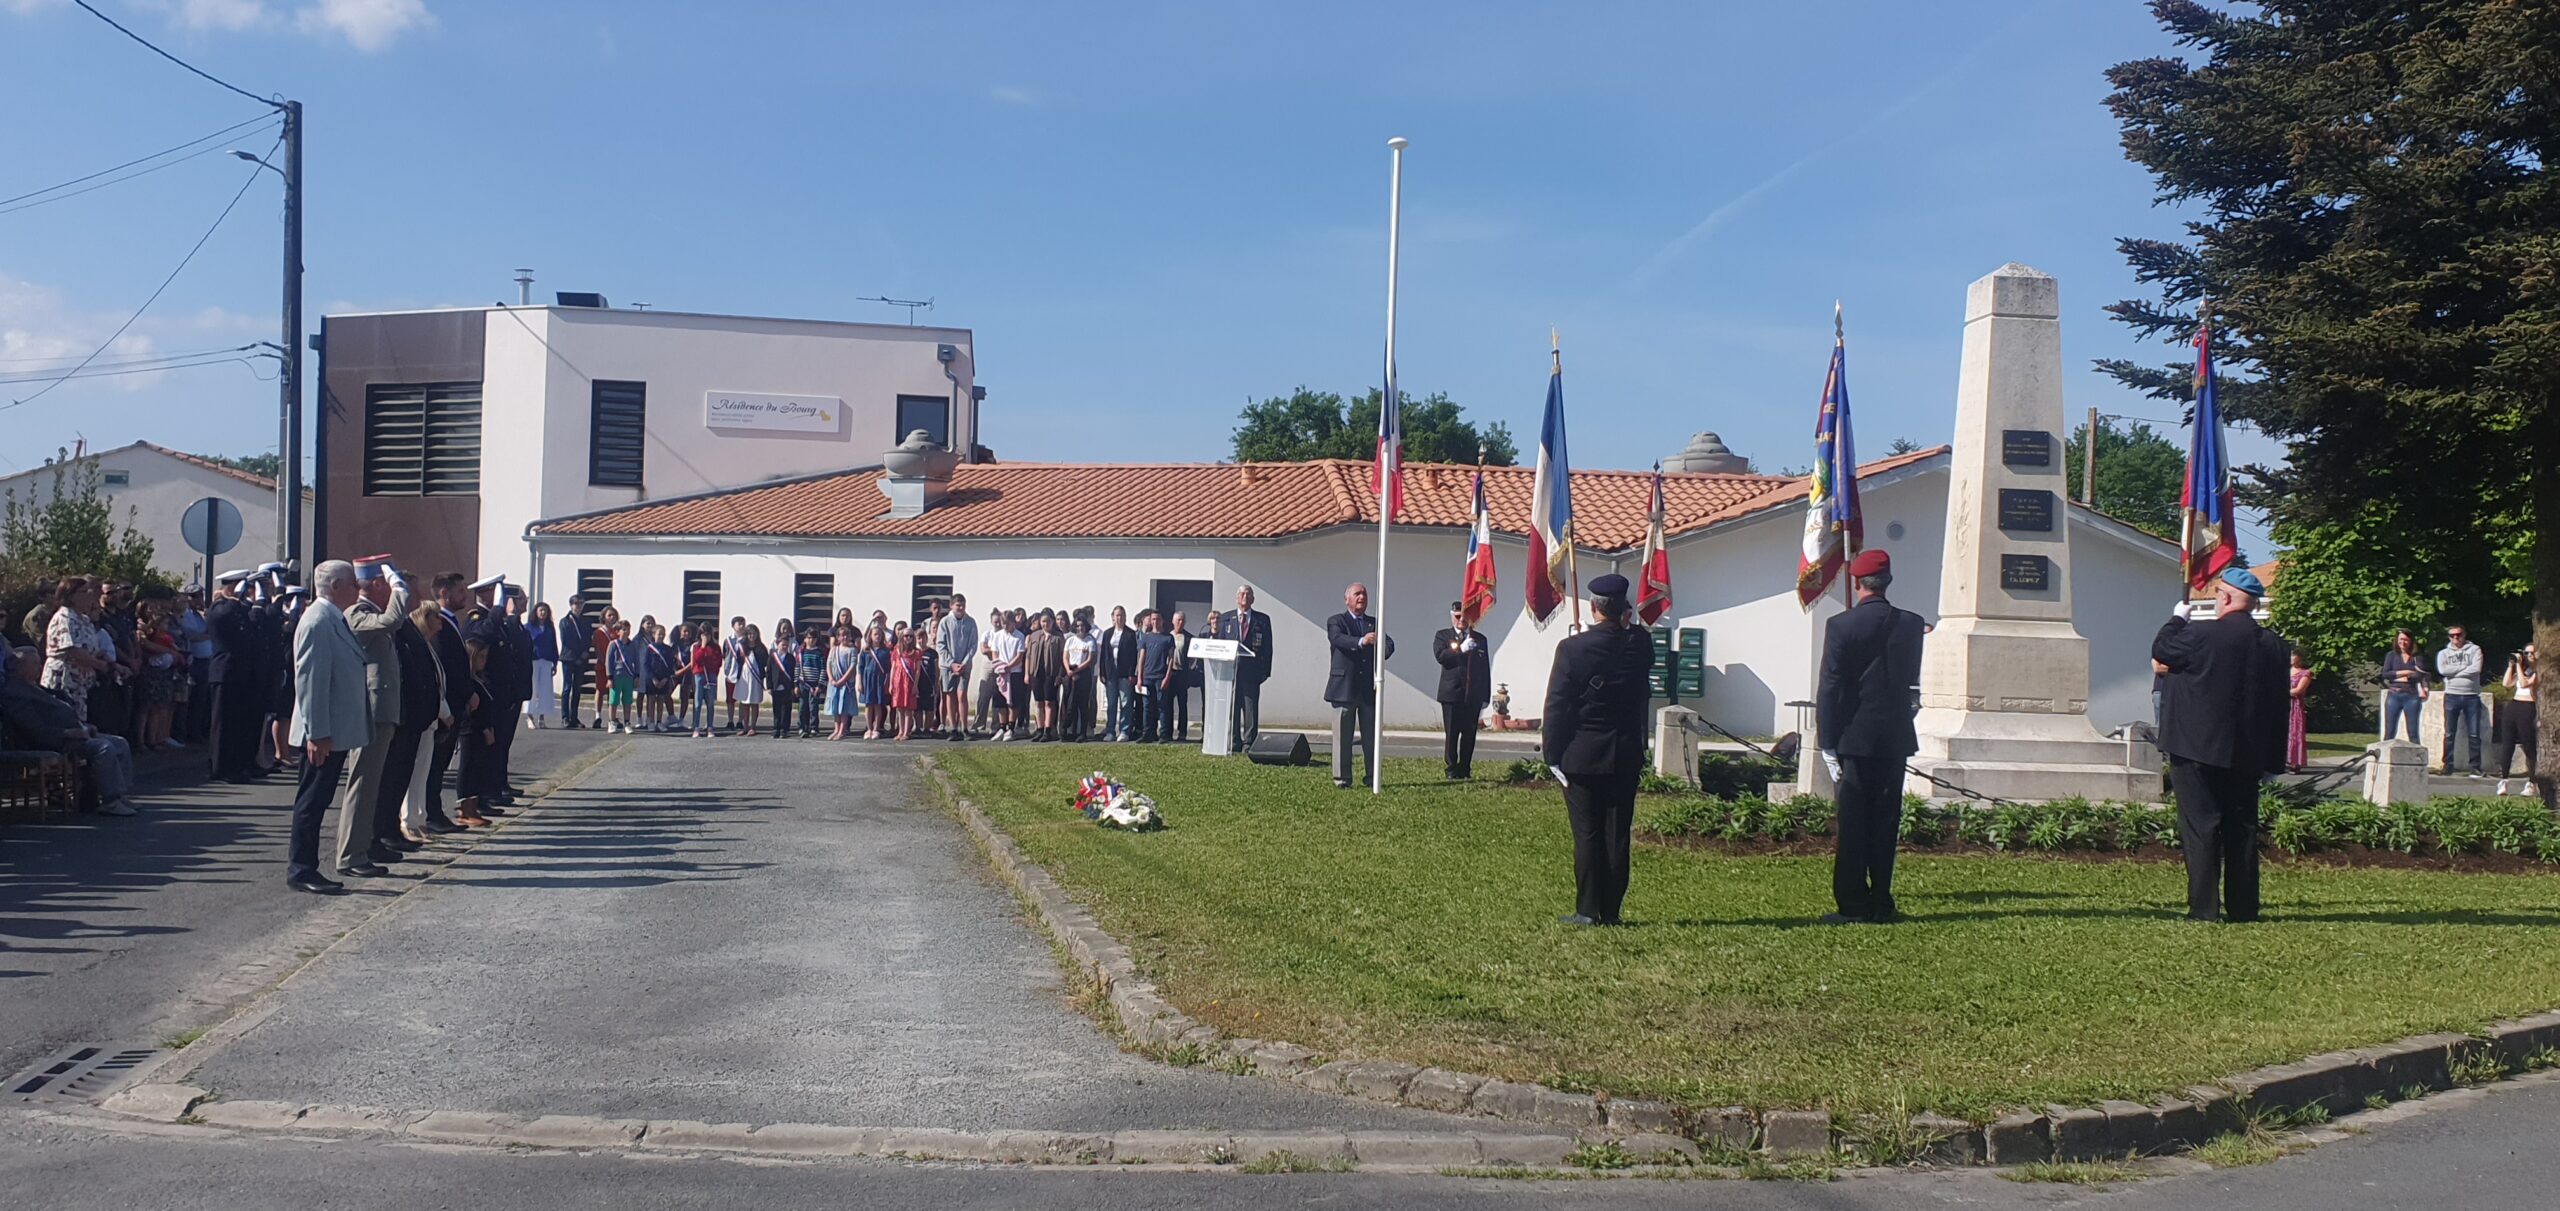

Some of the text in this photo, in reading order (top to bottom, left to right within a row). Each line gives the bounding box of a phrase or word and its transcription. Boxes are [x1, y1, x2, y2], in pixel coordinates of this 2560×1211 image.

[712, 399, 817, 417] Résidence du Bourg
